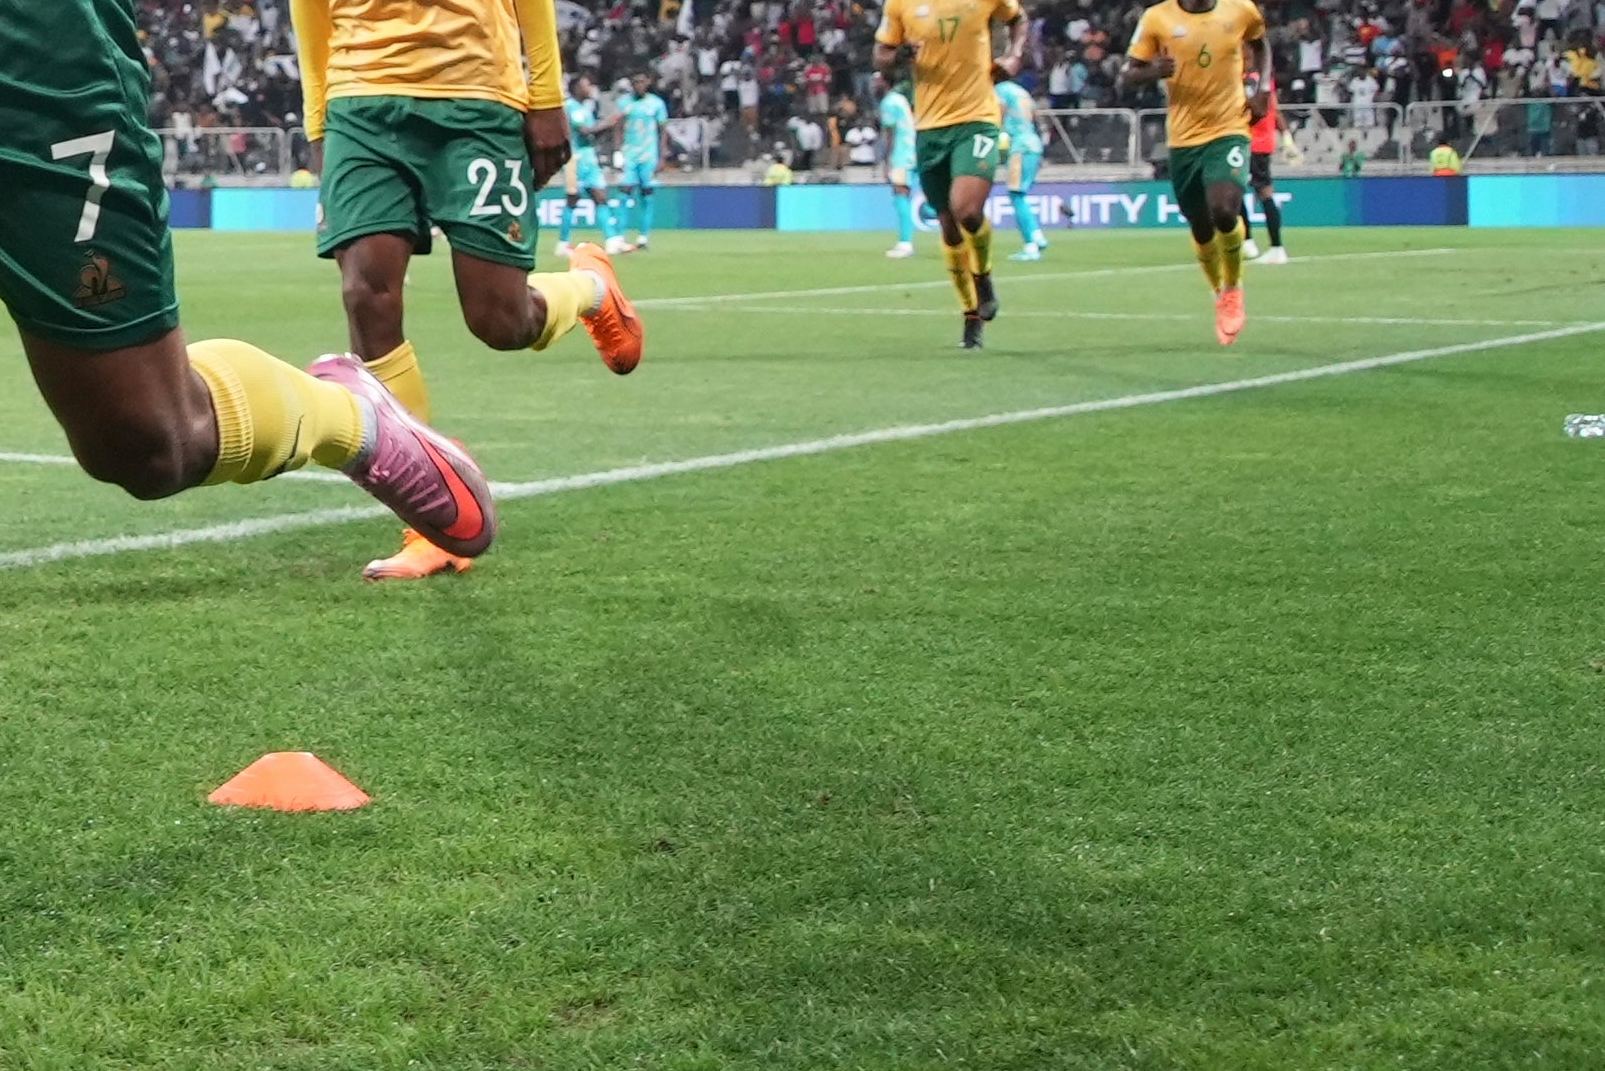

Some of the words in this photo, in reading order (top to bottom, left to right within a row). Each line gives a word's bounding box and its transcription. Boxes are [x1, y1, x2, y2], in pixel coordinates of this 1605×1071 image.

[938, 17, 961, 43] 17
[1197, 43, 1211, 68] 6
[972, 134, 994, 159] 17
[1226, 146, 1244, 167] 6
[51, 130, 116, 242] 7
[467, 158, 528, 217] 23
